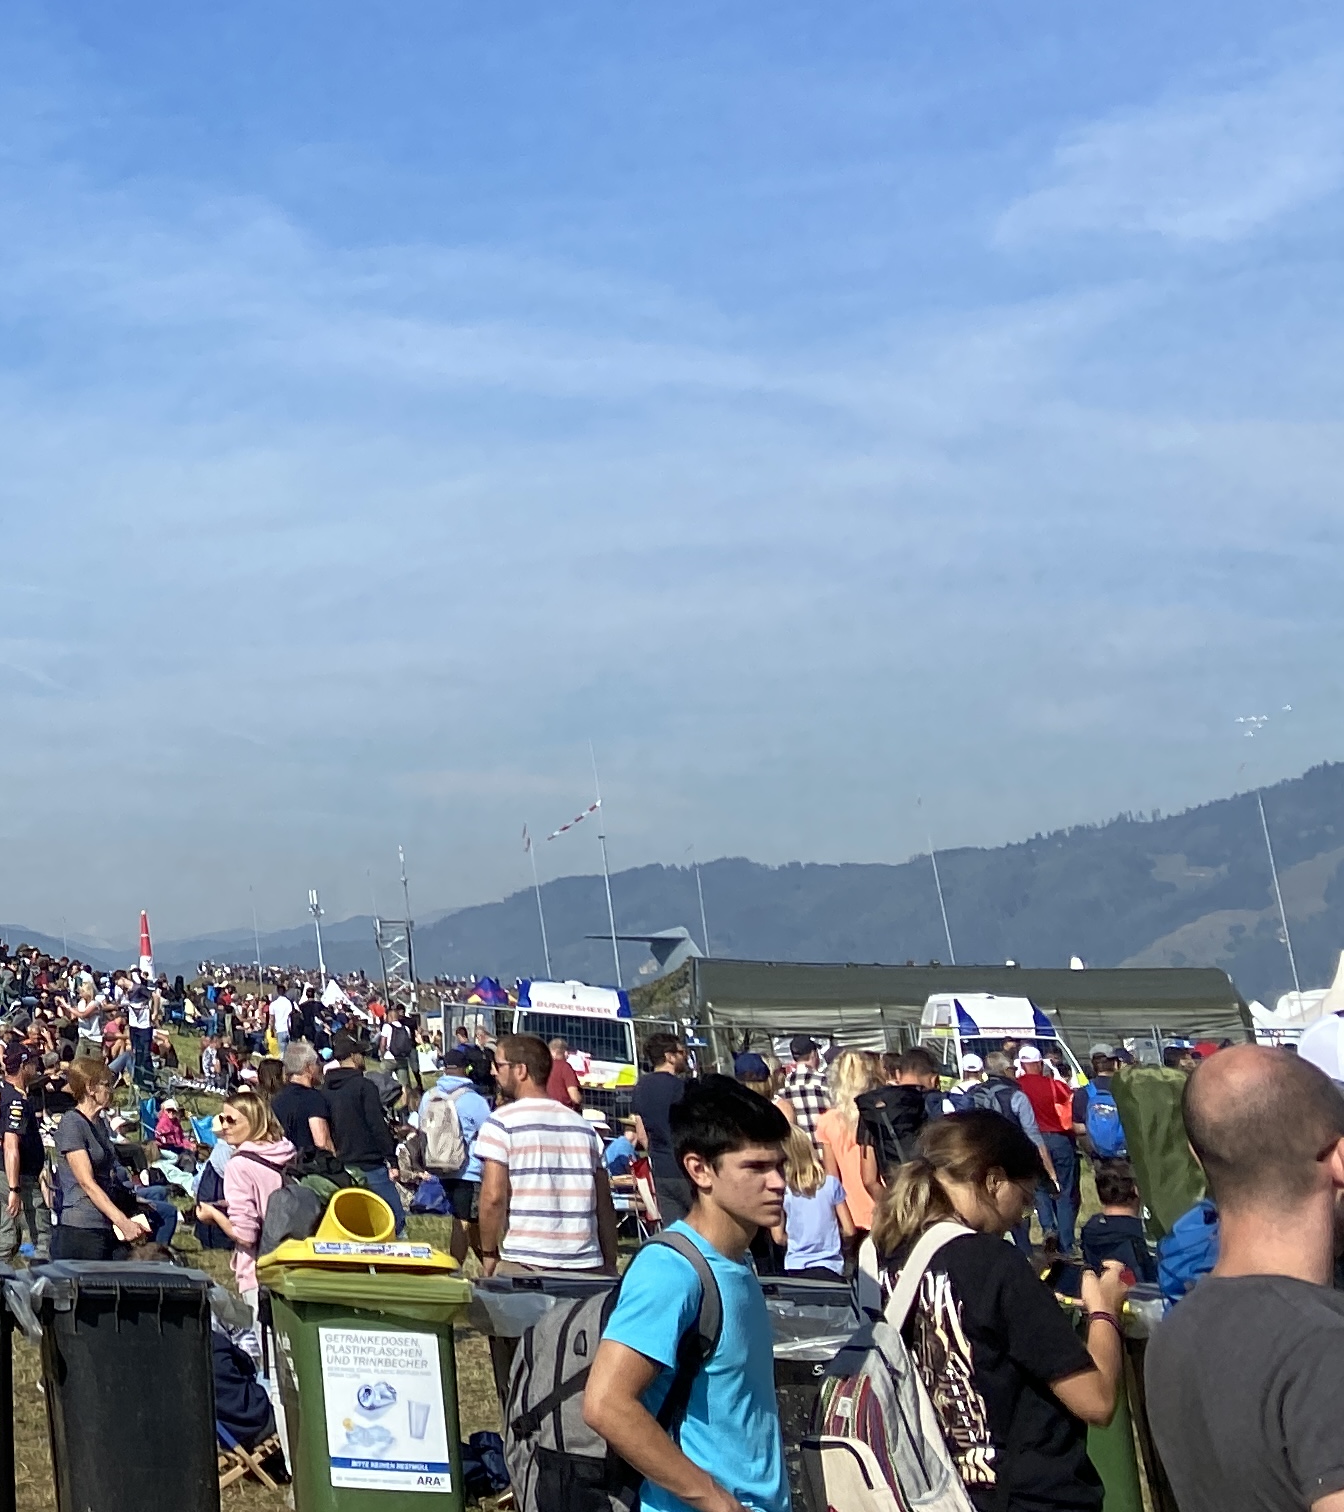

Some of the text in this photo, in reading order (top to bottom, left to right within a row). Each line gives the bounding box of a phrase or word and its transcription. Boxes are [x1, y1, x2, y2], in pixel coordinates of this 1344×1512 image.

[536, 1000, 612, 1015] BUNDESHEER
[325, 1344, 423, 1358] PLASTIKFLASCHEN
[326, 1355, 429, 1369] UND TRINKBECHER
[416, 1475, 441, 1486] ARA
